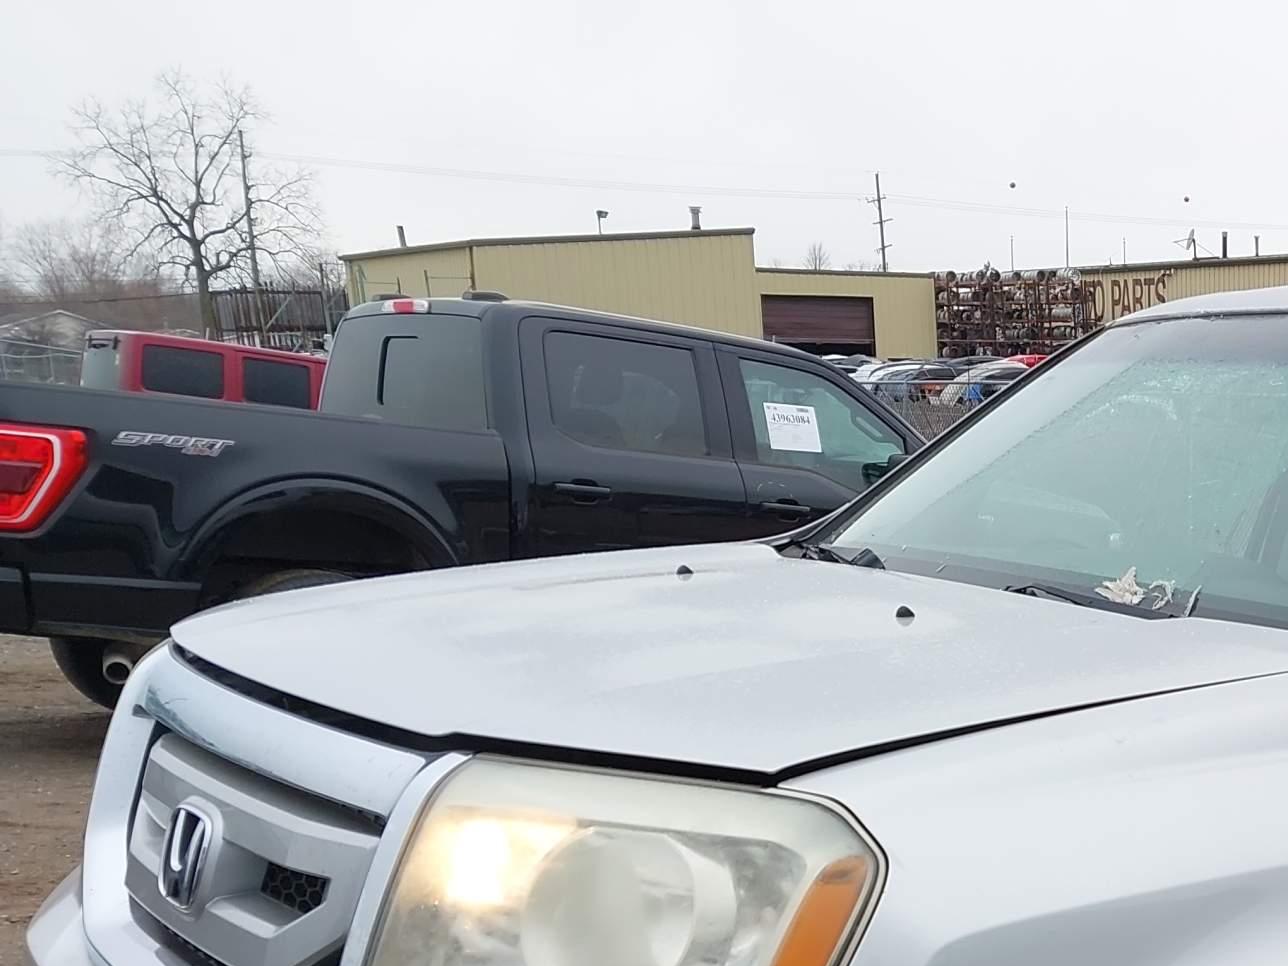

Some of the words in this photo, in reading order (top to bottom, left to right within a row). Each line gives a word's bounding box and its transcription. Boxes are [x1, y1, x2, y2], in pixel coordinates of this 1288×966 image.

[1111, 277, 1167, 320] PARTS
[771, 413, 811, 425] 43963084
[111, 431, 236, 453] SPORT
